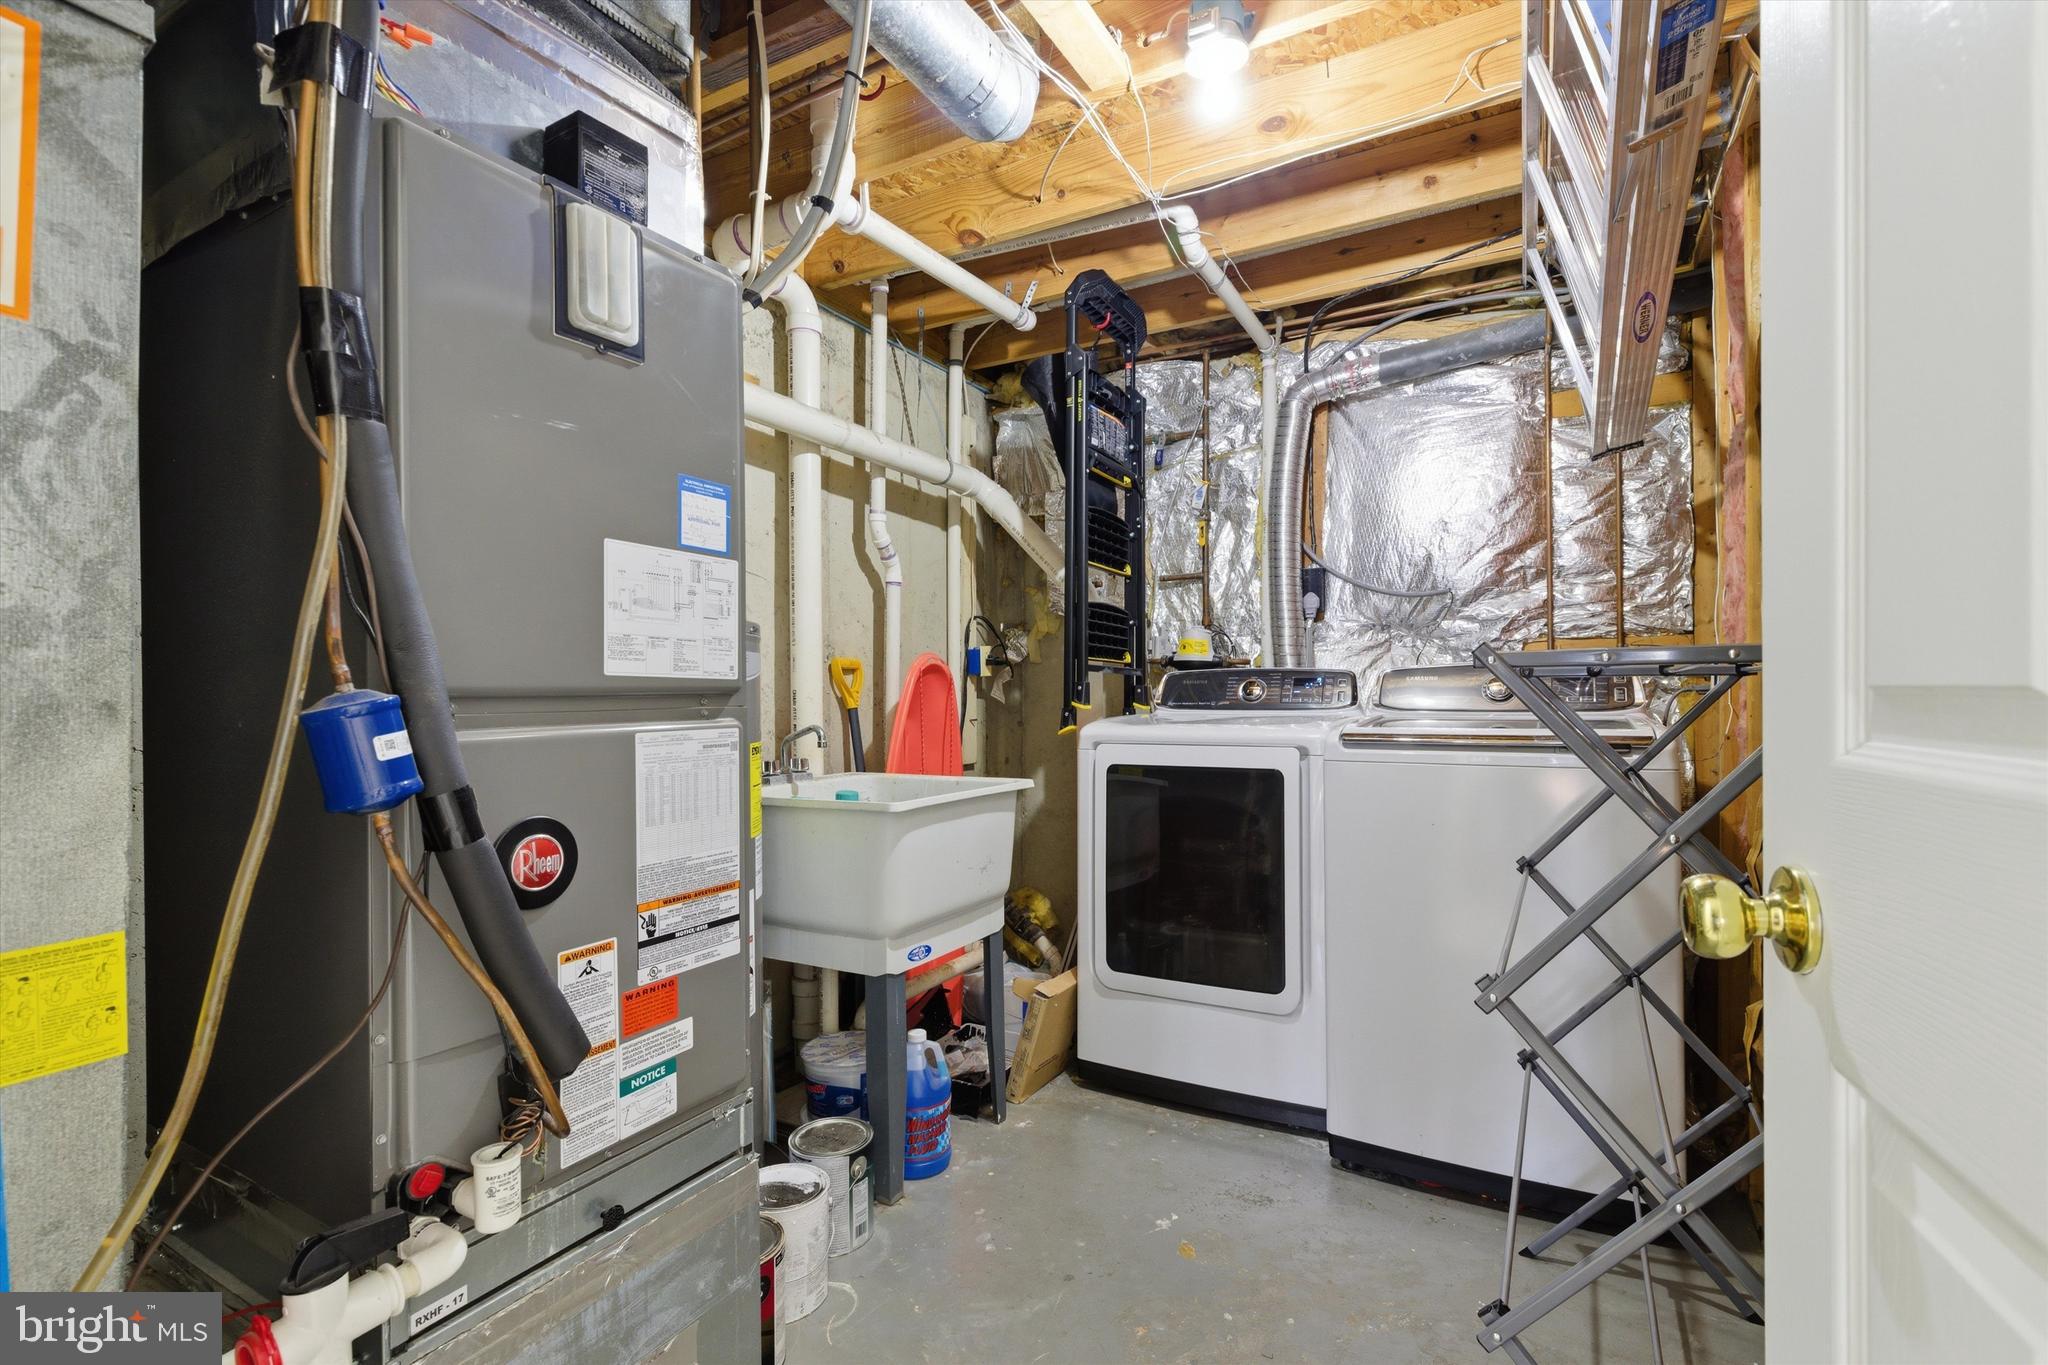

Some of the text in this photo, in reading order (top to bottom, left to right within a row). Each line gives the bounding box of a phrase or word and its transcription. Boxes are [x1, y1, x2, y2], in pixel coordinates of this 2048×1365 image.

[519, 841, 561, 883] Rheem
[663, 894, 692, 905] WARNING
[571, 942, 612, 960] WARNING
[625, 979, 676, 1002] WARNING
[631, 1065, 666, 1090] NOTICE
[415, 1304, 444, 1327] RXHF
[452, 1292, 465, 1306] 17
